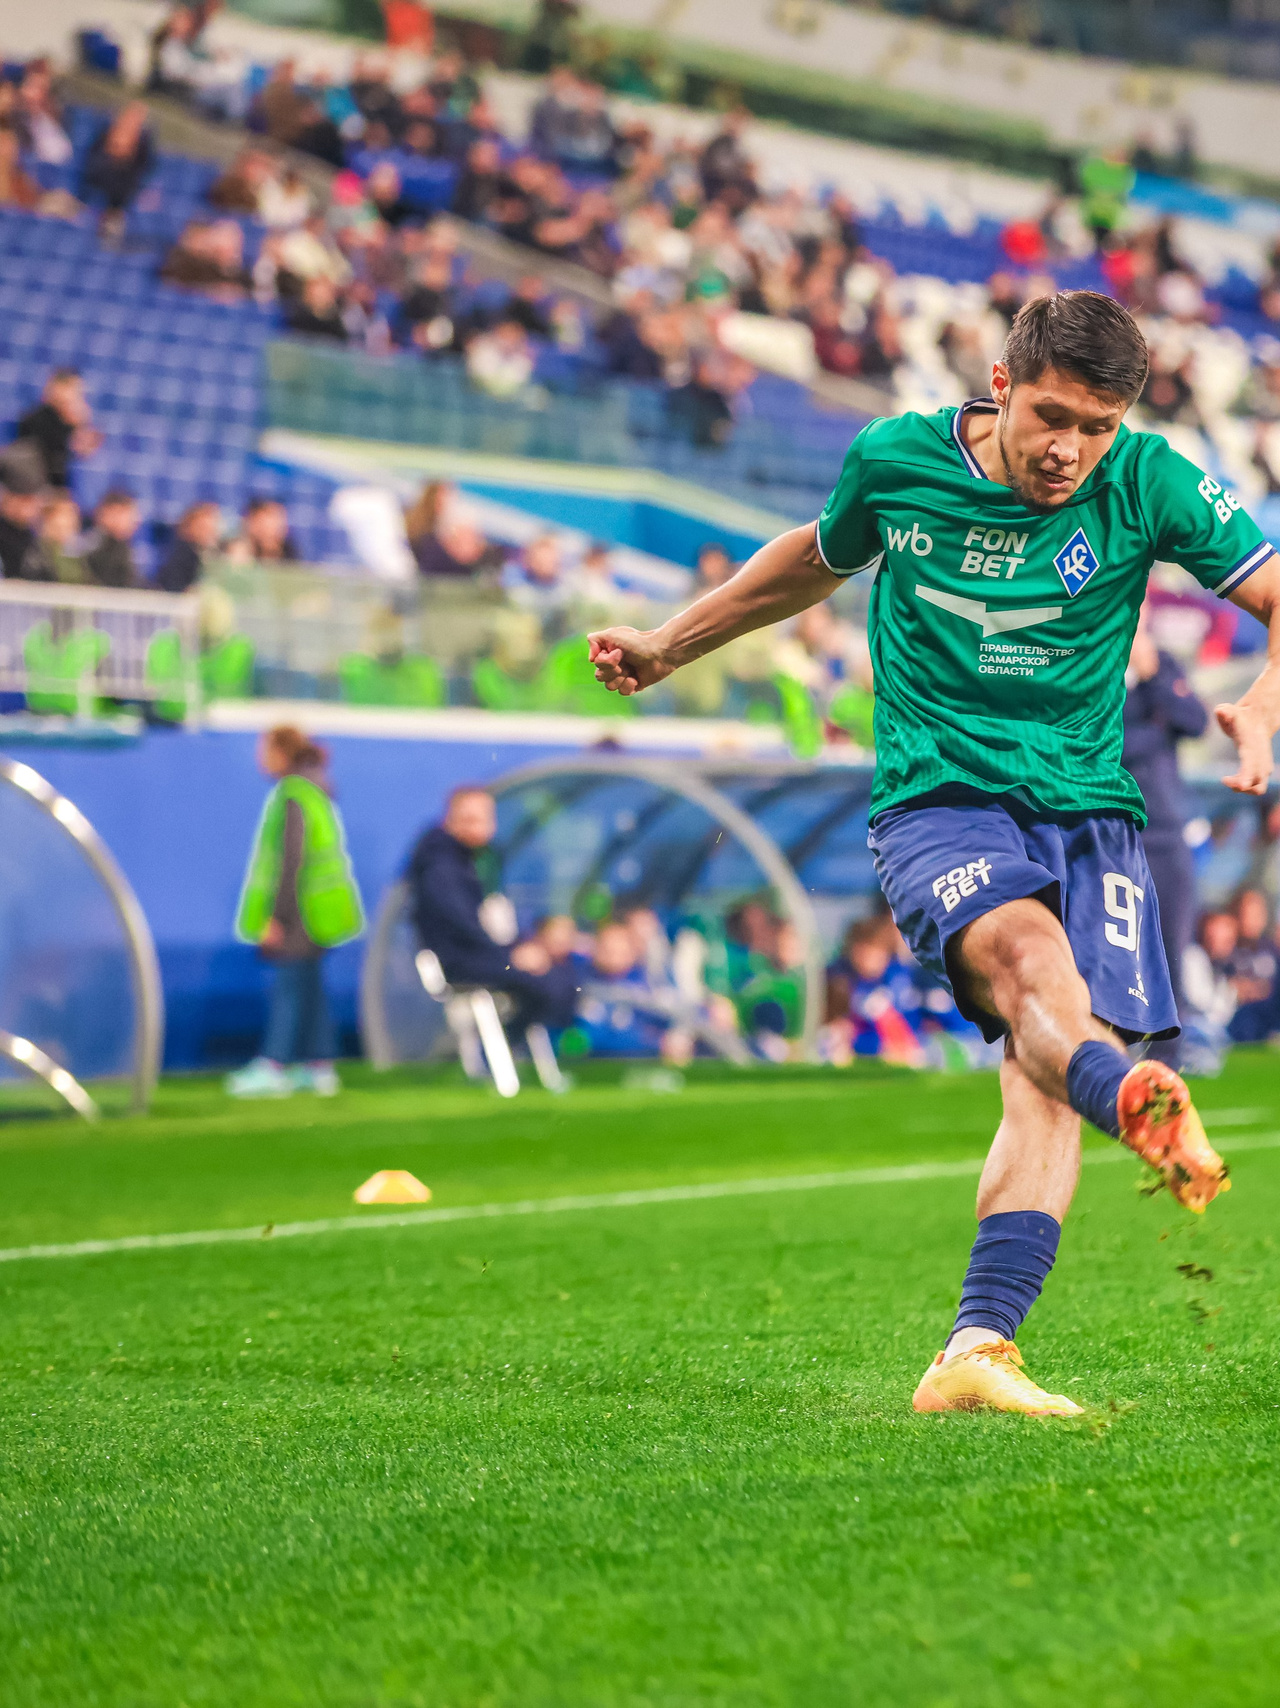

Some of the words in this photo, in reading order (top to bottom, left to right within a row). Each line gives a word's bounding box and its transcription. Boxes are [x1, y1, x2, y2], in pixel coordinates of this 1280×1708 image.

[887, 522, 933, 557] wb
[963, 526, 1029, 554] FON
[960, 550, 1026, 579] BET
[979, 654, 1050, 666] САМАРСКОЙ
[980, 643, 1075, 657] ПРАВИТЕЛЬСТВО
[978, 665, 1034, 676] ОБЛАСТИ
[932, 857, 986, 898] FON
[941, 864, 993, 913] BET
[1102, 872, 1144, 962] 9
